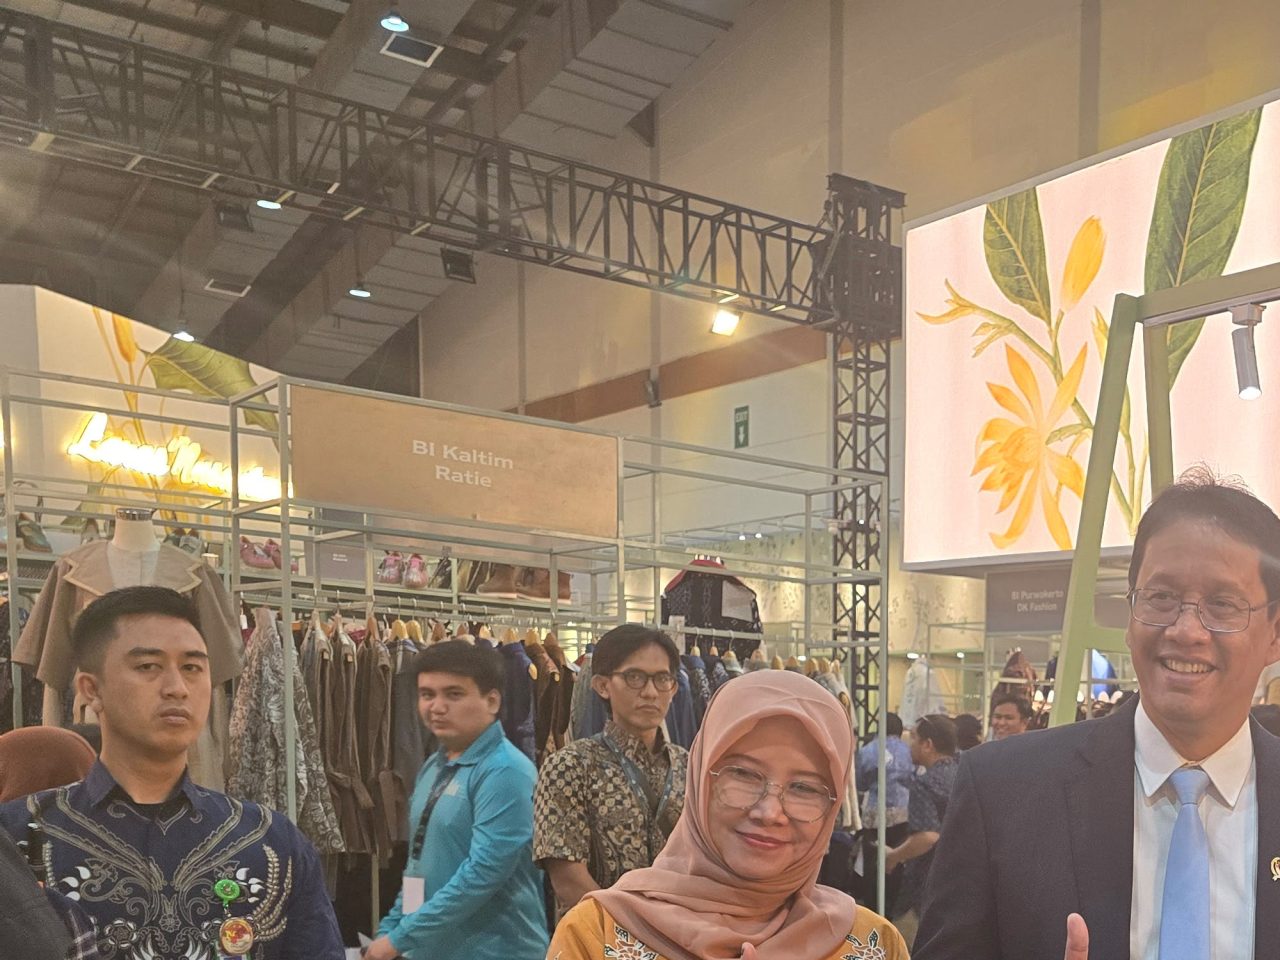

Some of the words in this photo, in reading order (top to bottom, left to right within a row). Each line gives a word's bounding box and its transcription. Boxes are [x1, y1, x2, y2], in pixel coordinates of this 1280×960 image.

[412, 440, 435, 457] BI
[443, 444, 514, 470] Kaltim
[435, 464, 492, 488] Ratie
